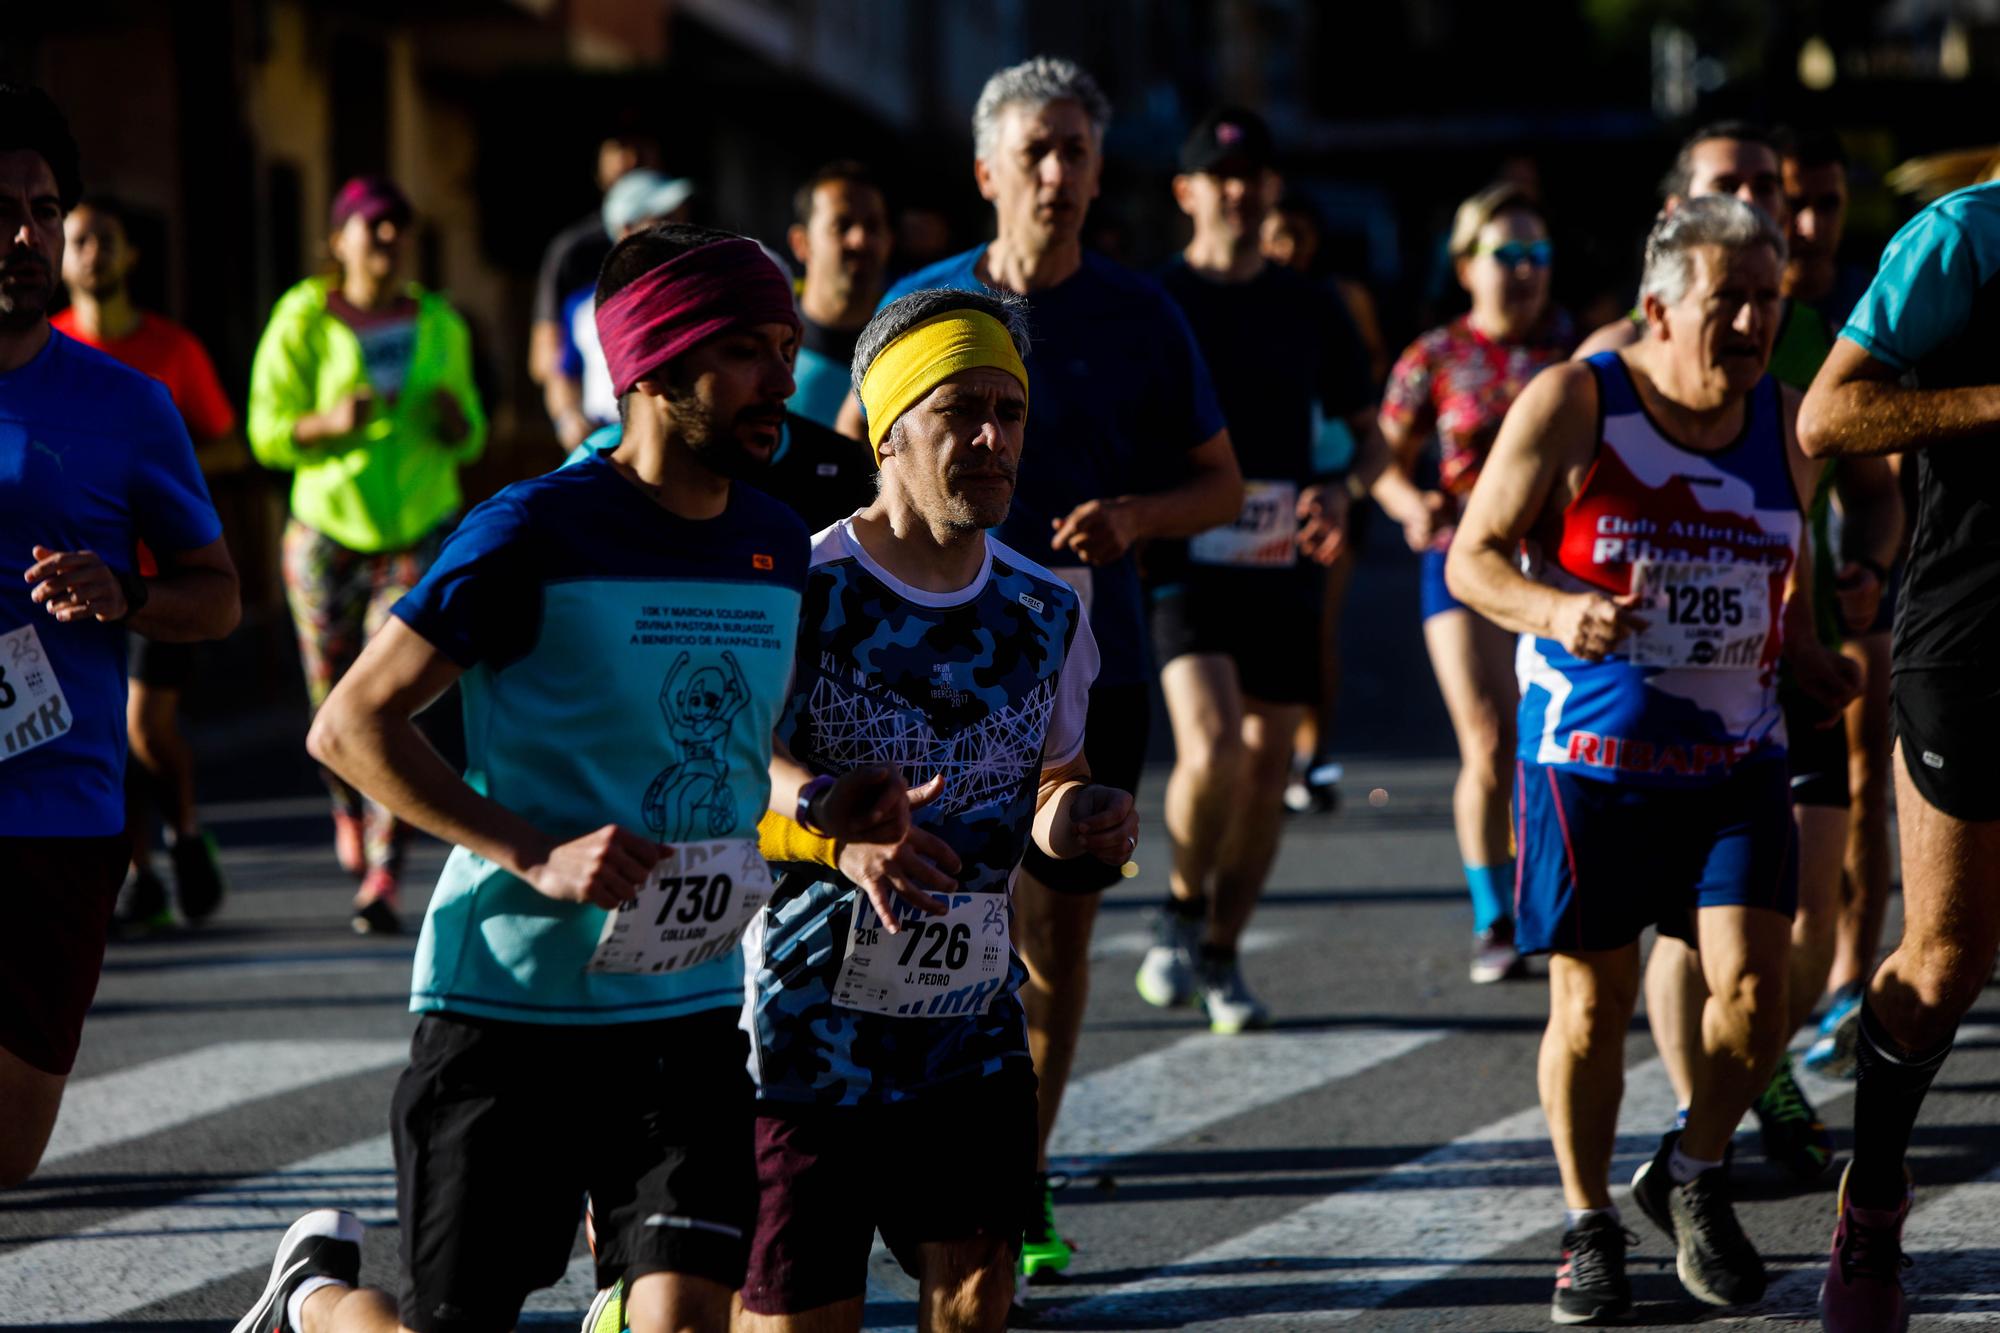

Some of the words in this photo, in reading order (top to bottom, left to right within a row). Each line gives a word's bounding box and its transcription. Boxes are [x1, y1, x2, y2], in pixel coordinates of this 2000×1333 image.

[1596, 514, 1658, 535] Club
[1665, 585, 1742, 626] 1285
[662, 607, 670, 616] Y
[671, 607, 713, 618] MARCHA
[716, 608, 767, 621] SOLIDARIA
[635, 620, 673, 630] DIVINA
[674, 620, 720, 632] PASTORA
[721, 622, 775, 635] BURJASSOT
[630, 634, 639, 645] A
[641, 634, 696, 646] BENEFICIO
[698, 635, 712, 646] DE
[655, 873, 732, 926] 730
[660, 927, 707, 942] COLLADO
[898, 919, 971, 970] 726
[904, 972, 914, 985] J.
[917, 972, 950, 986] PEDRO
